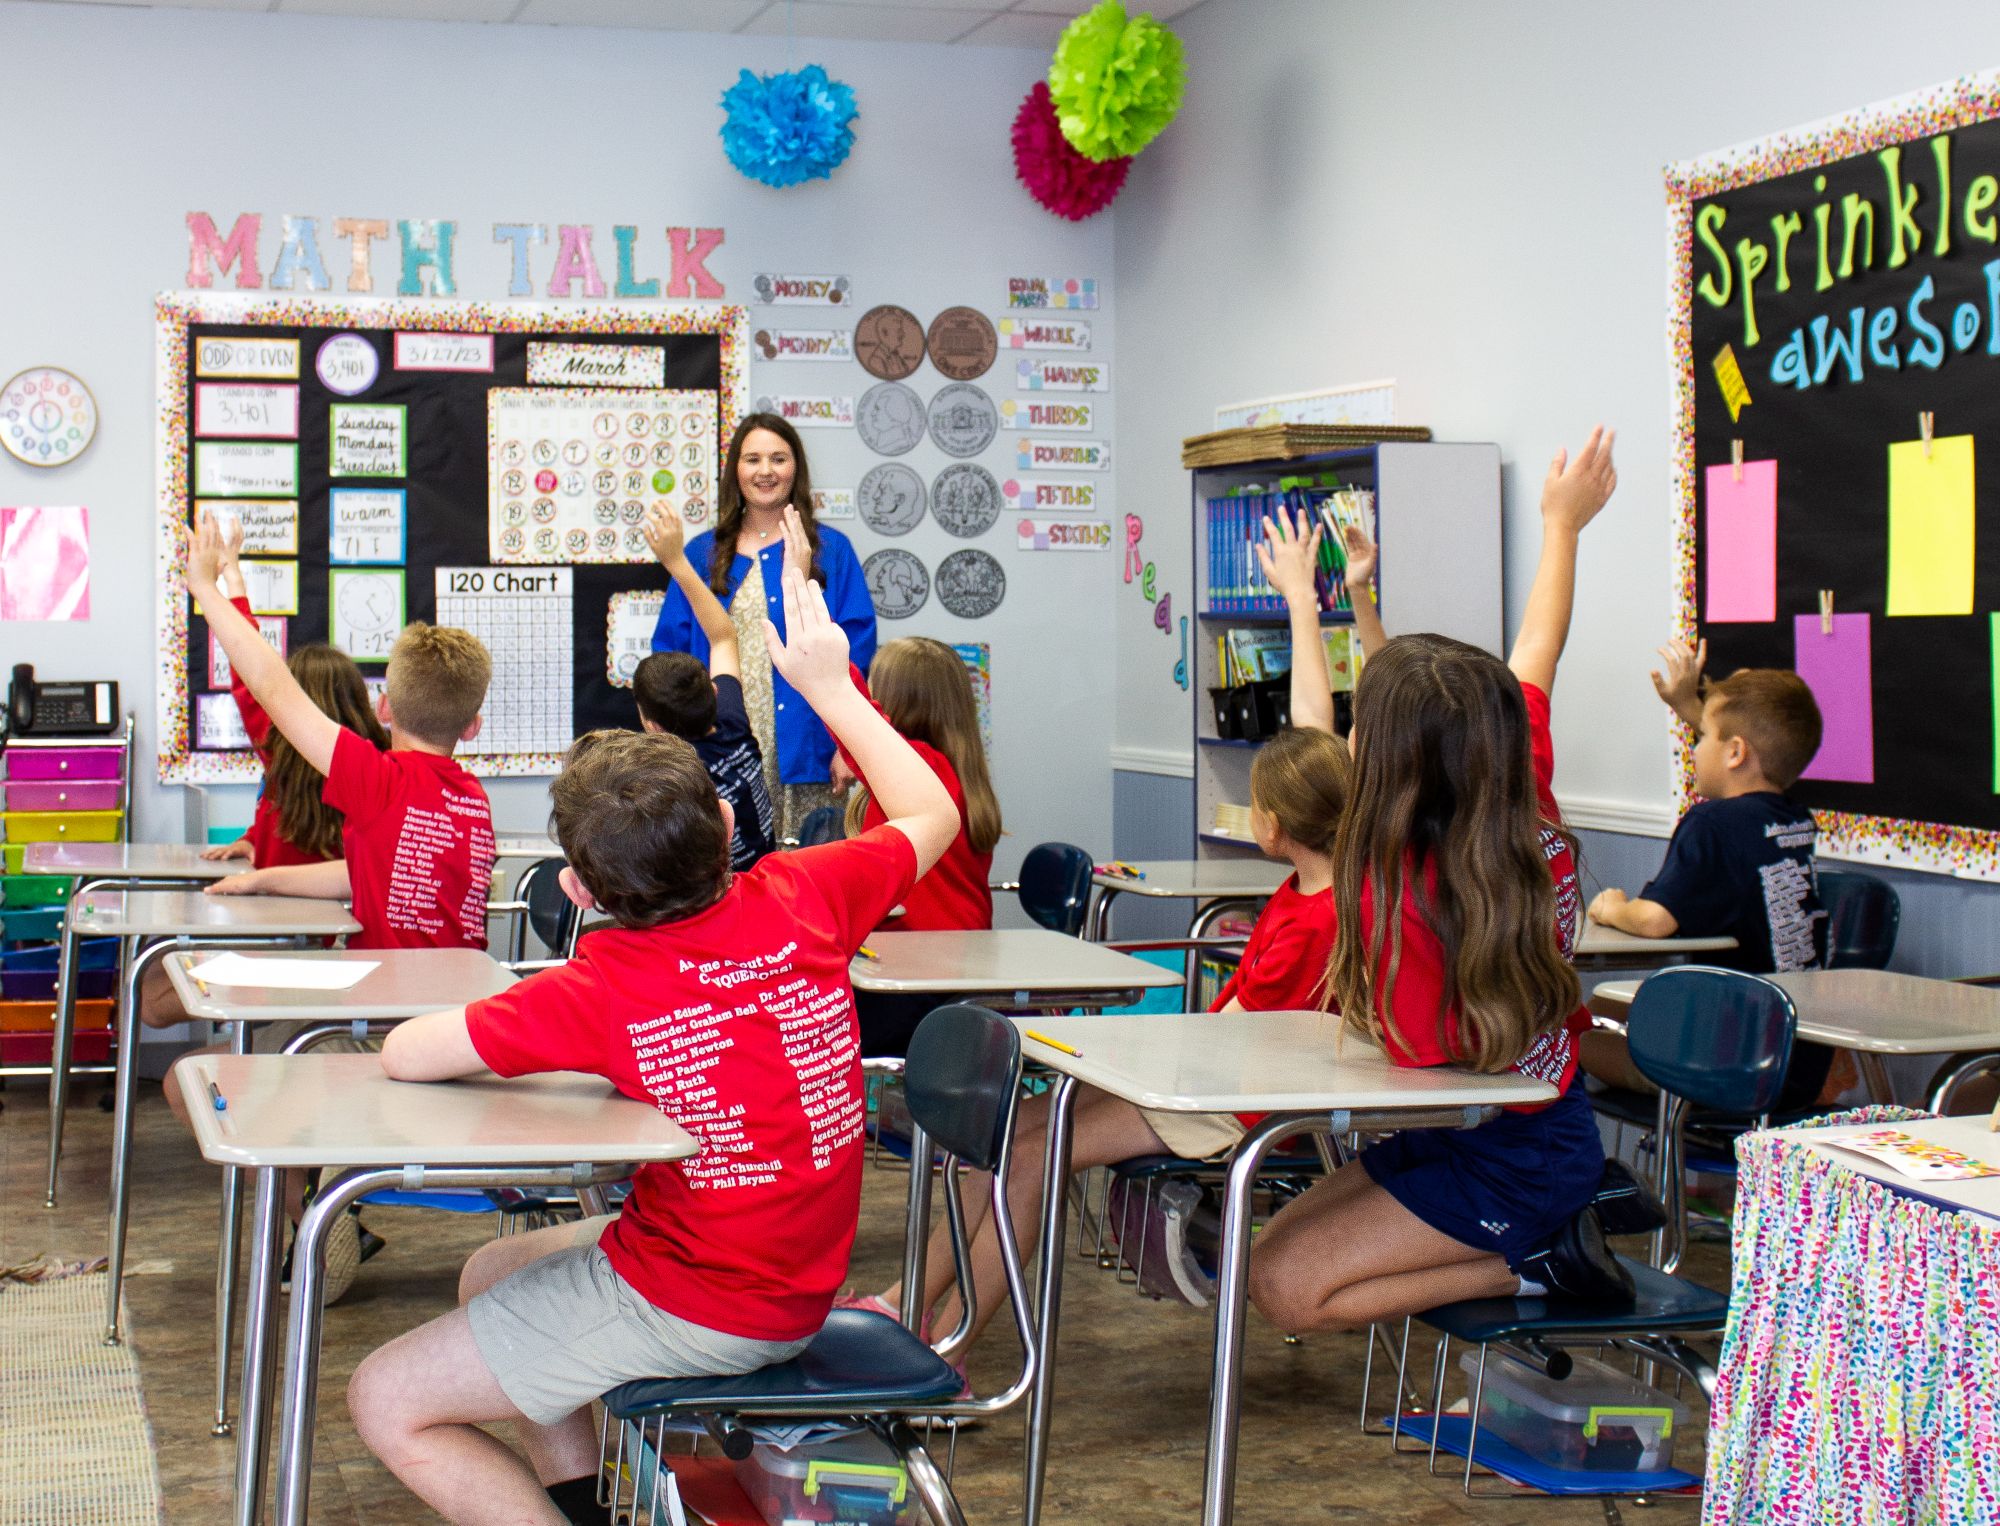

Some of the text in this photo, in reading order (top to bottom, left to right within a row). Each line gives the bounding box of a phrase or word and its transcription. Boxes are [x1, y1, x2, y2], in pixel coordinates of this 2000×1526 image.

[186, 211, 725, 297] MATH TALK
[774, 280, 831, 297] MONEY
[778, 336, 832, 354] PENNY
[203, 346, 231, 366] ODD
[261, 348, 294, 367] EVEN
[562, 357, 628, 377] March
[219, 401, 269, 425] 3,401
[1029, 404, 1090, 426] THIRDS
[338, 412, 397, 436] Sunday
[632, 418, 645, 431] 2
[660, 418, 669, 432] 3
[690, 418, 699, 431] 4
[508, 444, 518, 459] 5
[630, 447, 640, 461] 9
[656, 447, 671, 461] 10
[1034, 446, 1100, 463] FOURTHS
[598, 474, 612, 489] 15
[629, 476, 641, 490] 16
[689, 477, 703, 490] 18
[1035, 485, 1093, 505] FIFTHS
[508, 503, 704, 520] 19 20 22 23 25
[536, 532, 554, 547] 27
[600, 533, 616, 547] 29
[1049, 524, 1110, 545] SIXTHS
[449, 573, 558, 592] 120 Chart
[1124, 513, 1189, 691] Read
[699, 960, 720, 973] me
[759, 978, 807, 1003] Dr. Seuss
[765, 984, 819, 1013] Henry Ford
[809, 987, 845, 1012] Schwab
[627, 1002, 712, 1035] Thomas Edison
[631, 1003, 758, 1047] Alexander Graham Bell
[779, 1017, 815, 1032] Steven
[636, 1028, 720, 1059] Albert Einstein
[781, 1027, 821, 1045] Andrew
[638, 1037, 734, 1073] Sir Isaac Newton
[784, 1042, 811, 1058] John
[789, 1047, 831, 1068] Woodrow
[641, 1055, 720, 1086] Louis Pasteur
[796, 1060, 832, 1080] General
[676, 1074, 706, 1091] Ruth
[800, 1078, 848, 1106] Mark Twain
[684, 1086, 716, 1103] Ryan
[729, 1104, 746, 1118] Ali
[804, 1091, 851, 1118] Walt Disney
[706, 1119, 744, 1132] Stuart
[810, 1112, 841, 1132] Patricia
[709, 1131, 744, 1144] Burns
[812, 1126, 840, 1145] Agatha
[812, 1144, 833, 1157] Rep.
[833, 1132, 853, 1149] Larry
[682, 1157, 702, 1169] Jay
[683, 1159, 783, 1178] Winston Churchill
[813, 1155, 831, 1171] Me!
[713, 1176, 736, 1190] Phil
[738, 1173, 777, 1187] Bryant
